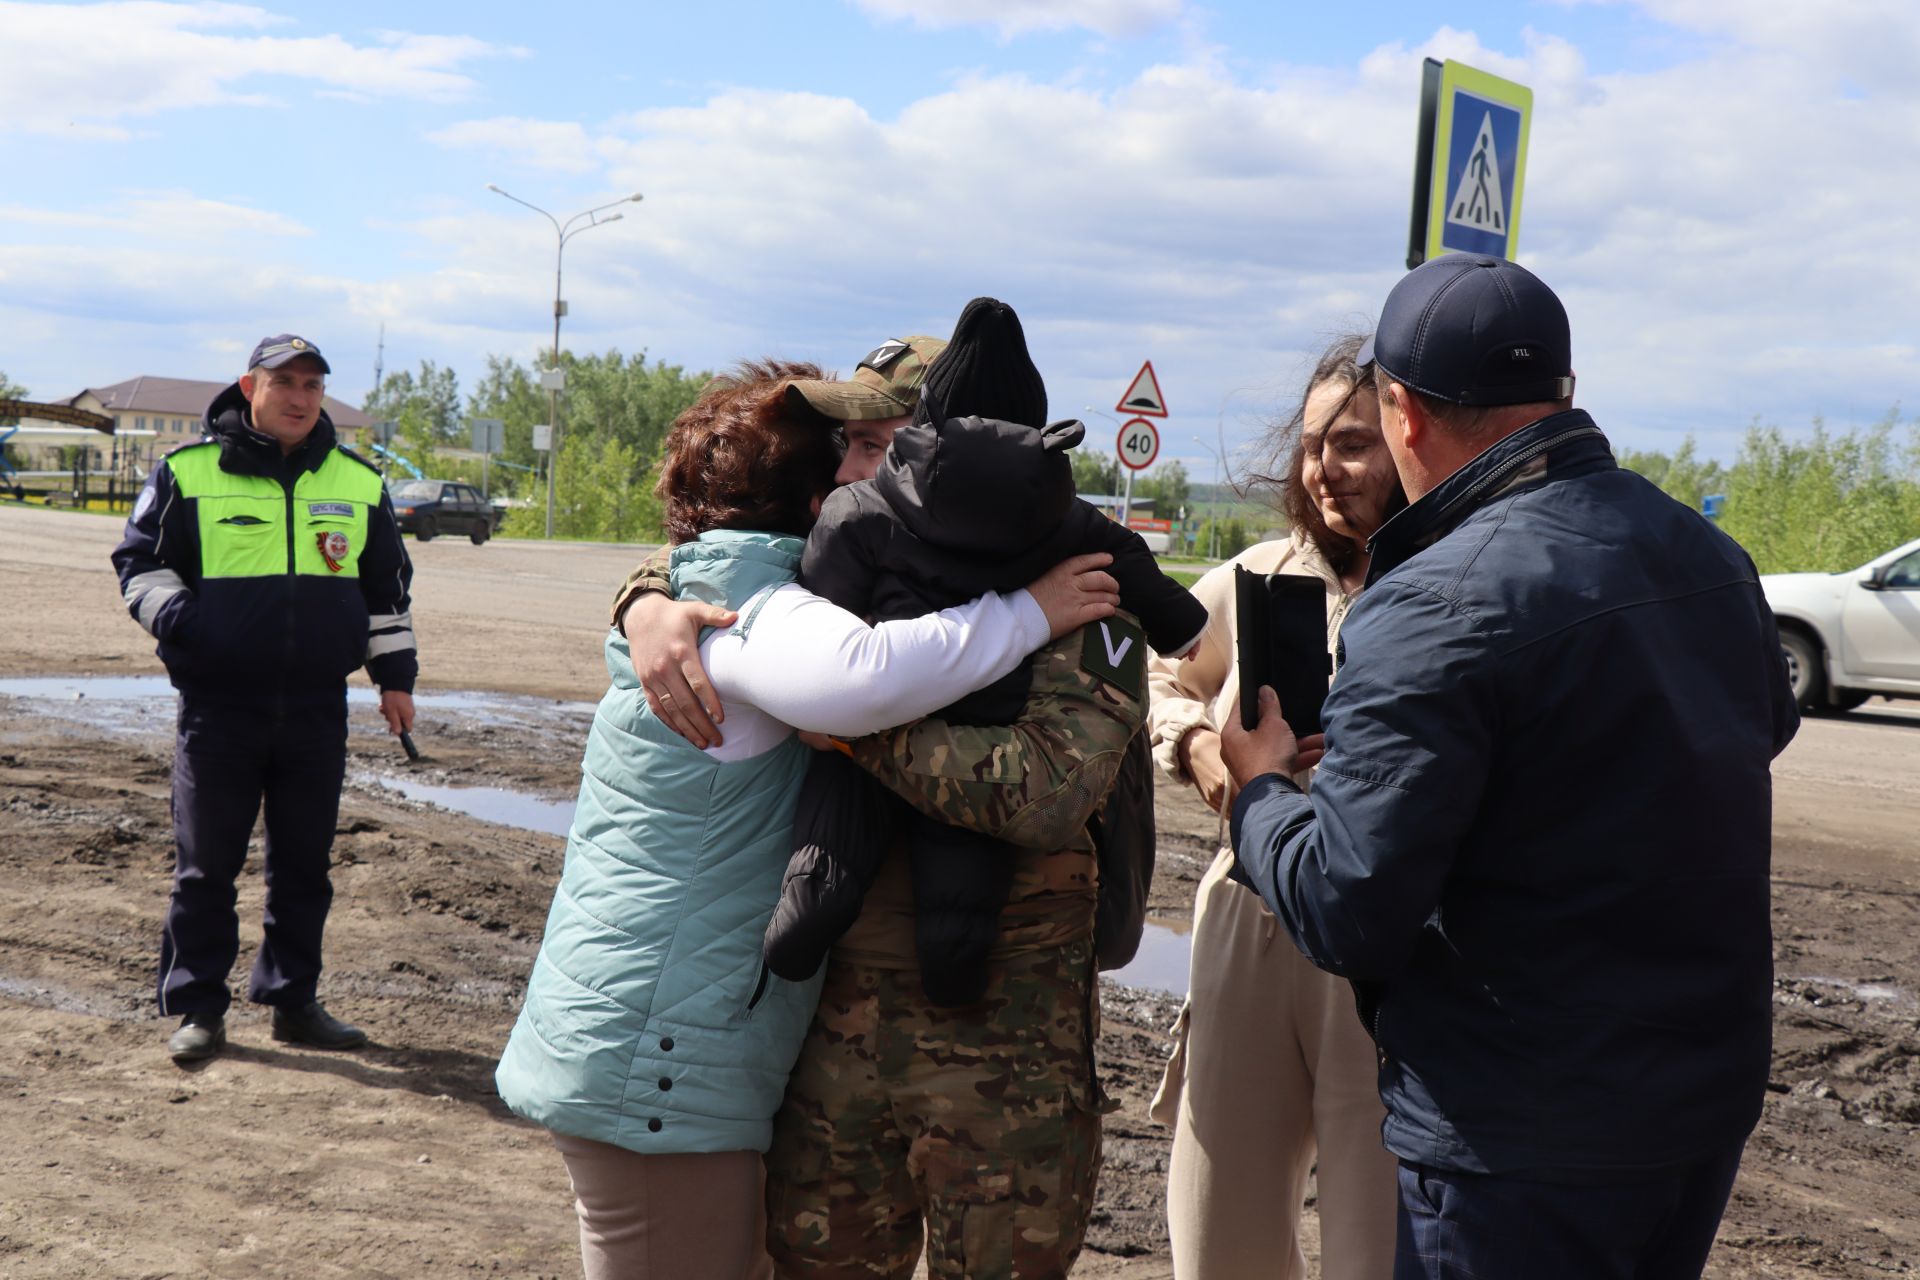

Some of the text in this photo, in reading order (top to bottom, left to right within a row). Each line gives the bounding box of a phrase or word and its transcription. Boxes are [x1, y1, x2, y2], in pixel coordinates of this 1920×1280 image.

[872, 347, 895, 364] V
[1126, 433, 1151, 454] 40
[1099, 621, 1133, 668] V
